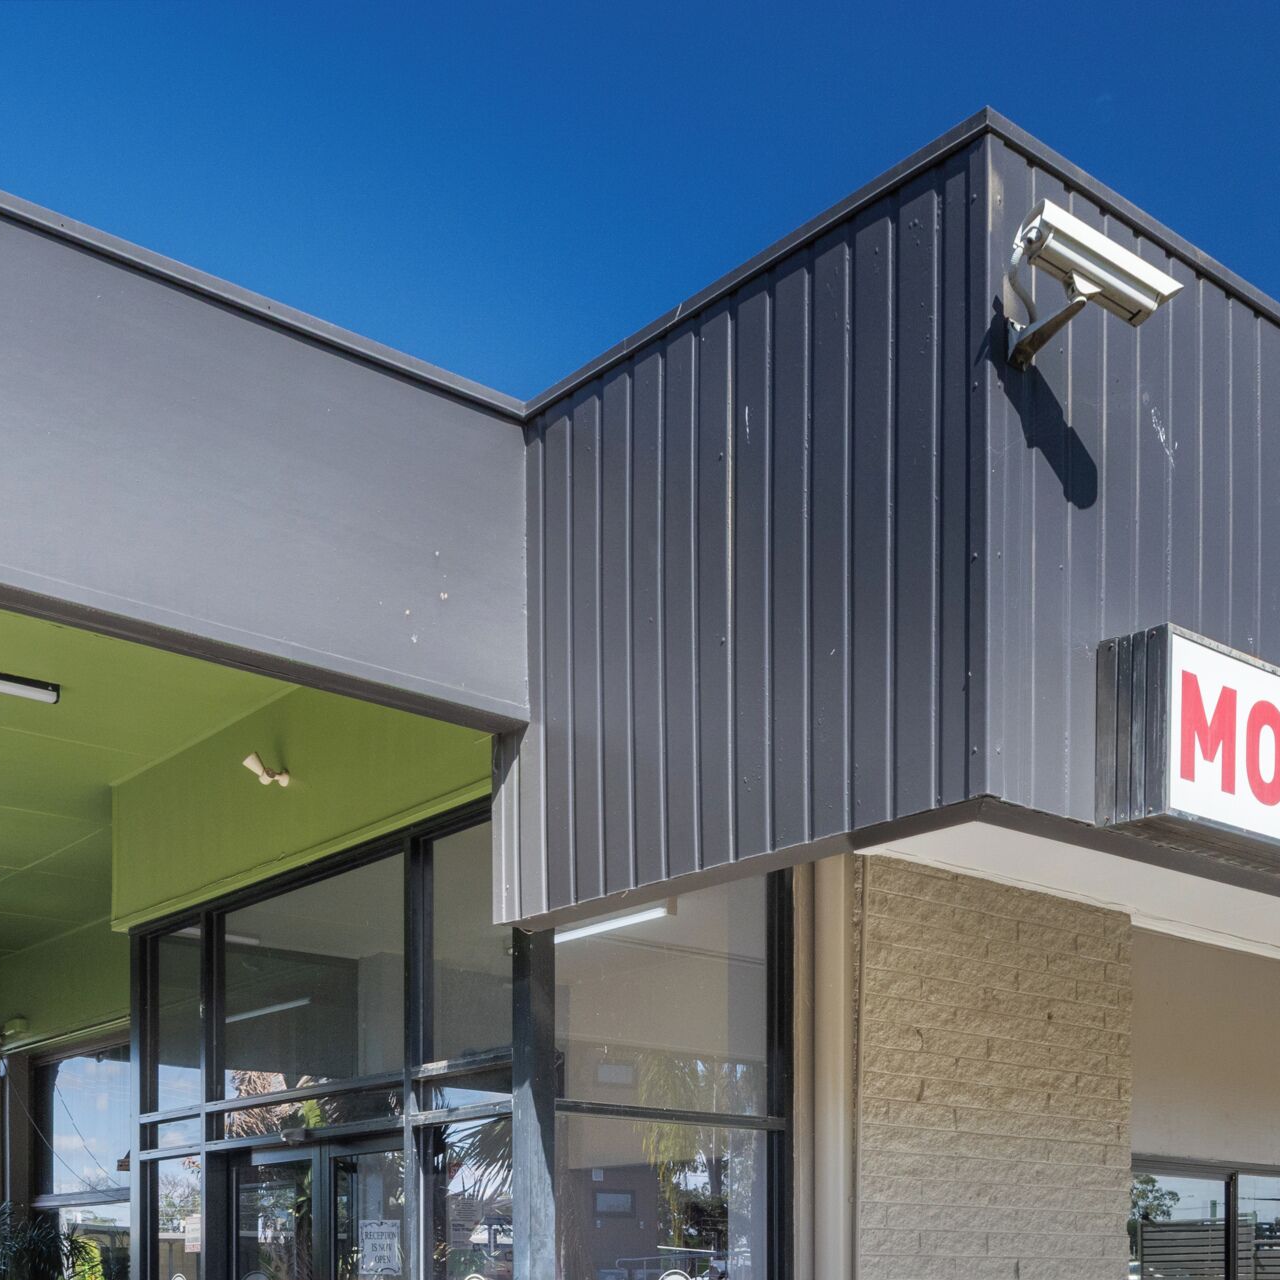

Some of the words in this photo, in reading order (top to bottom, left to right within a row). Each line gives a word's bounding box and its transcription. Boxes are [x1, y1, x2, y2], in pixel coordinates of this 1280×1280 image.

[365, 1232, 397, 1240] RECEPTION
[372, 1243, 378, 1252] IS
[374, 1255, 391, 1264] OPEN
